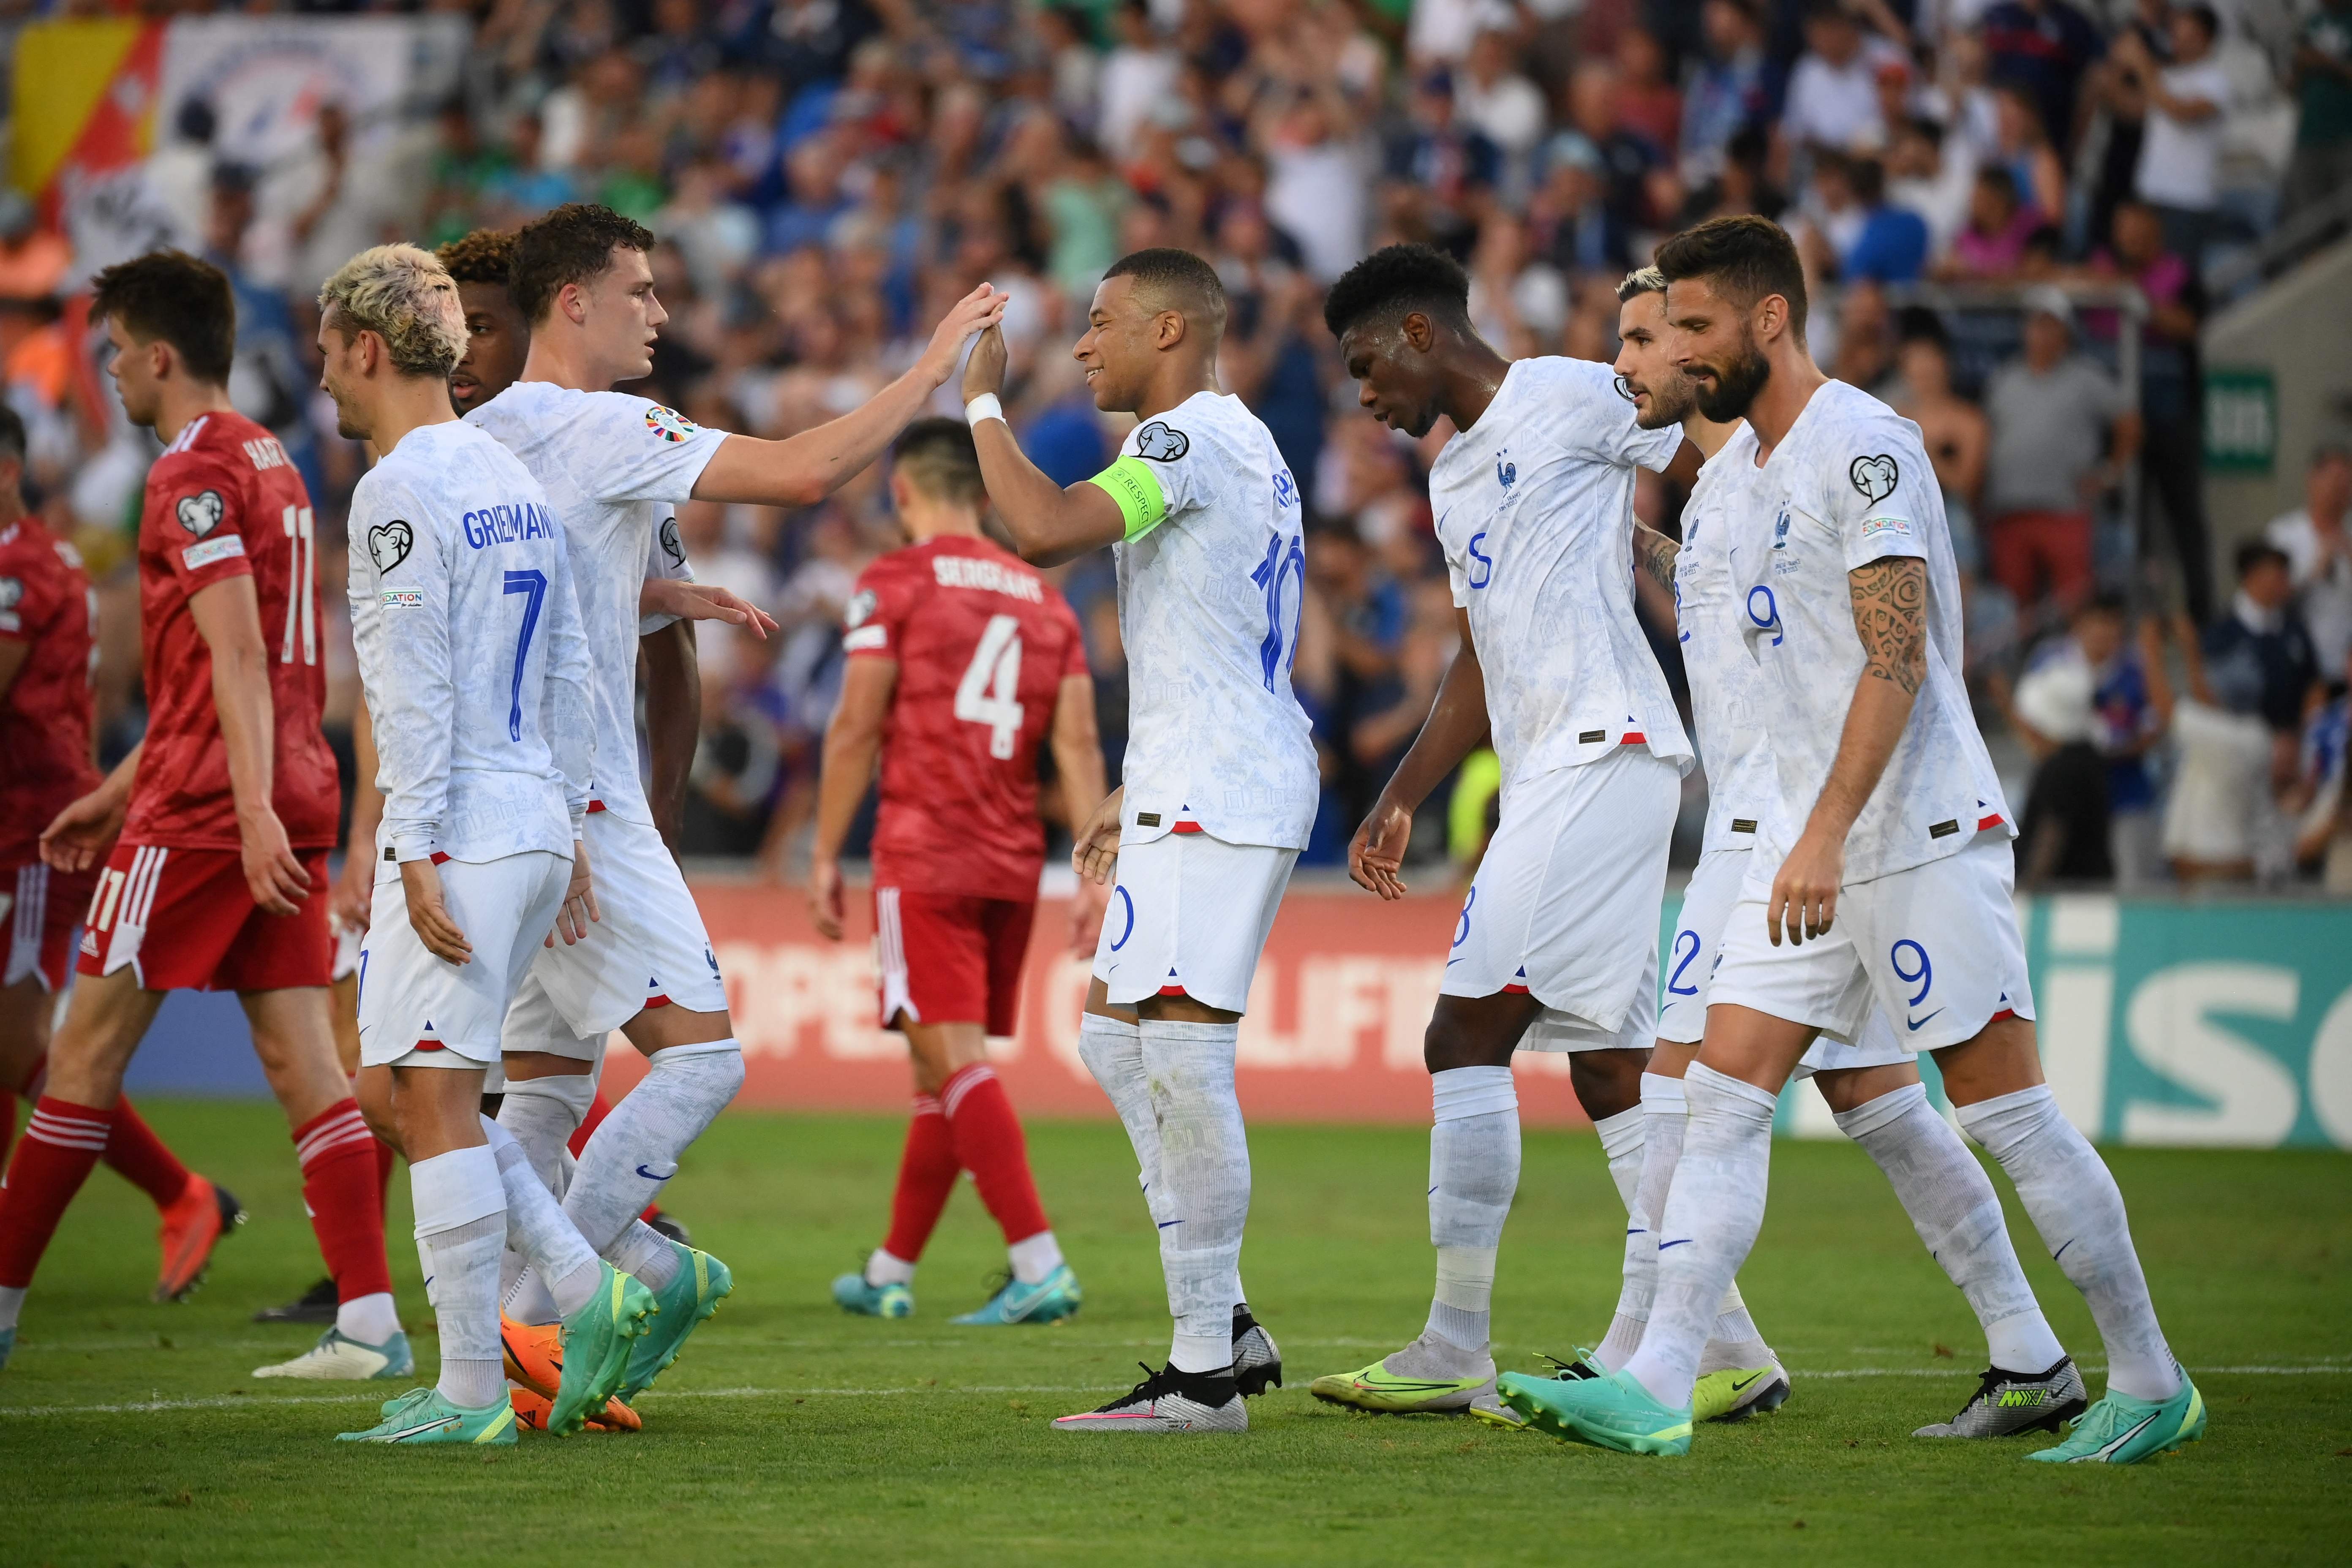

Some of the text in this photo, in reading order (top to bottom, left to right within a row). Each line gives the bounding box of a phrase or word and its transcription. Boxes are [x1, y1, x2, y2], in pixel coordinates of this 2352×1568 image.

[463, 502, 554, 549] GRIEMAN
[1124, 479, 1149, 524] RESPECT
[282, 504, 316, 666] 11
[933, 555, 1043, 604] SERGEANT
[1747, 585, 1783, 646] 9
[503, 569, 547, 742] 7
[954, 613, 1025, 760] 4
[86, 866, 125, 932] 11
[1892, 939, 1932, 1007] 9
